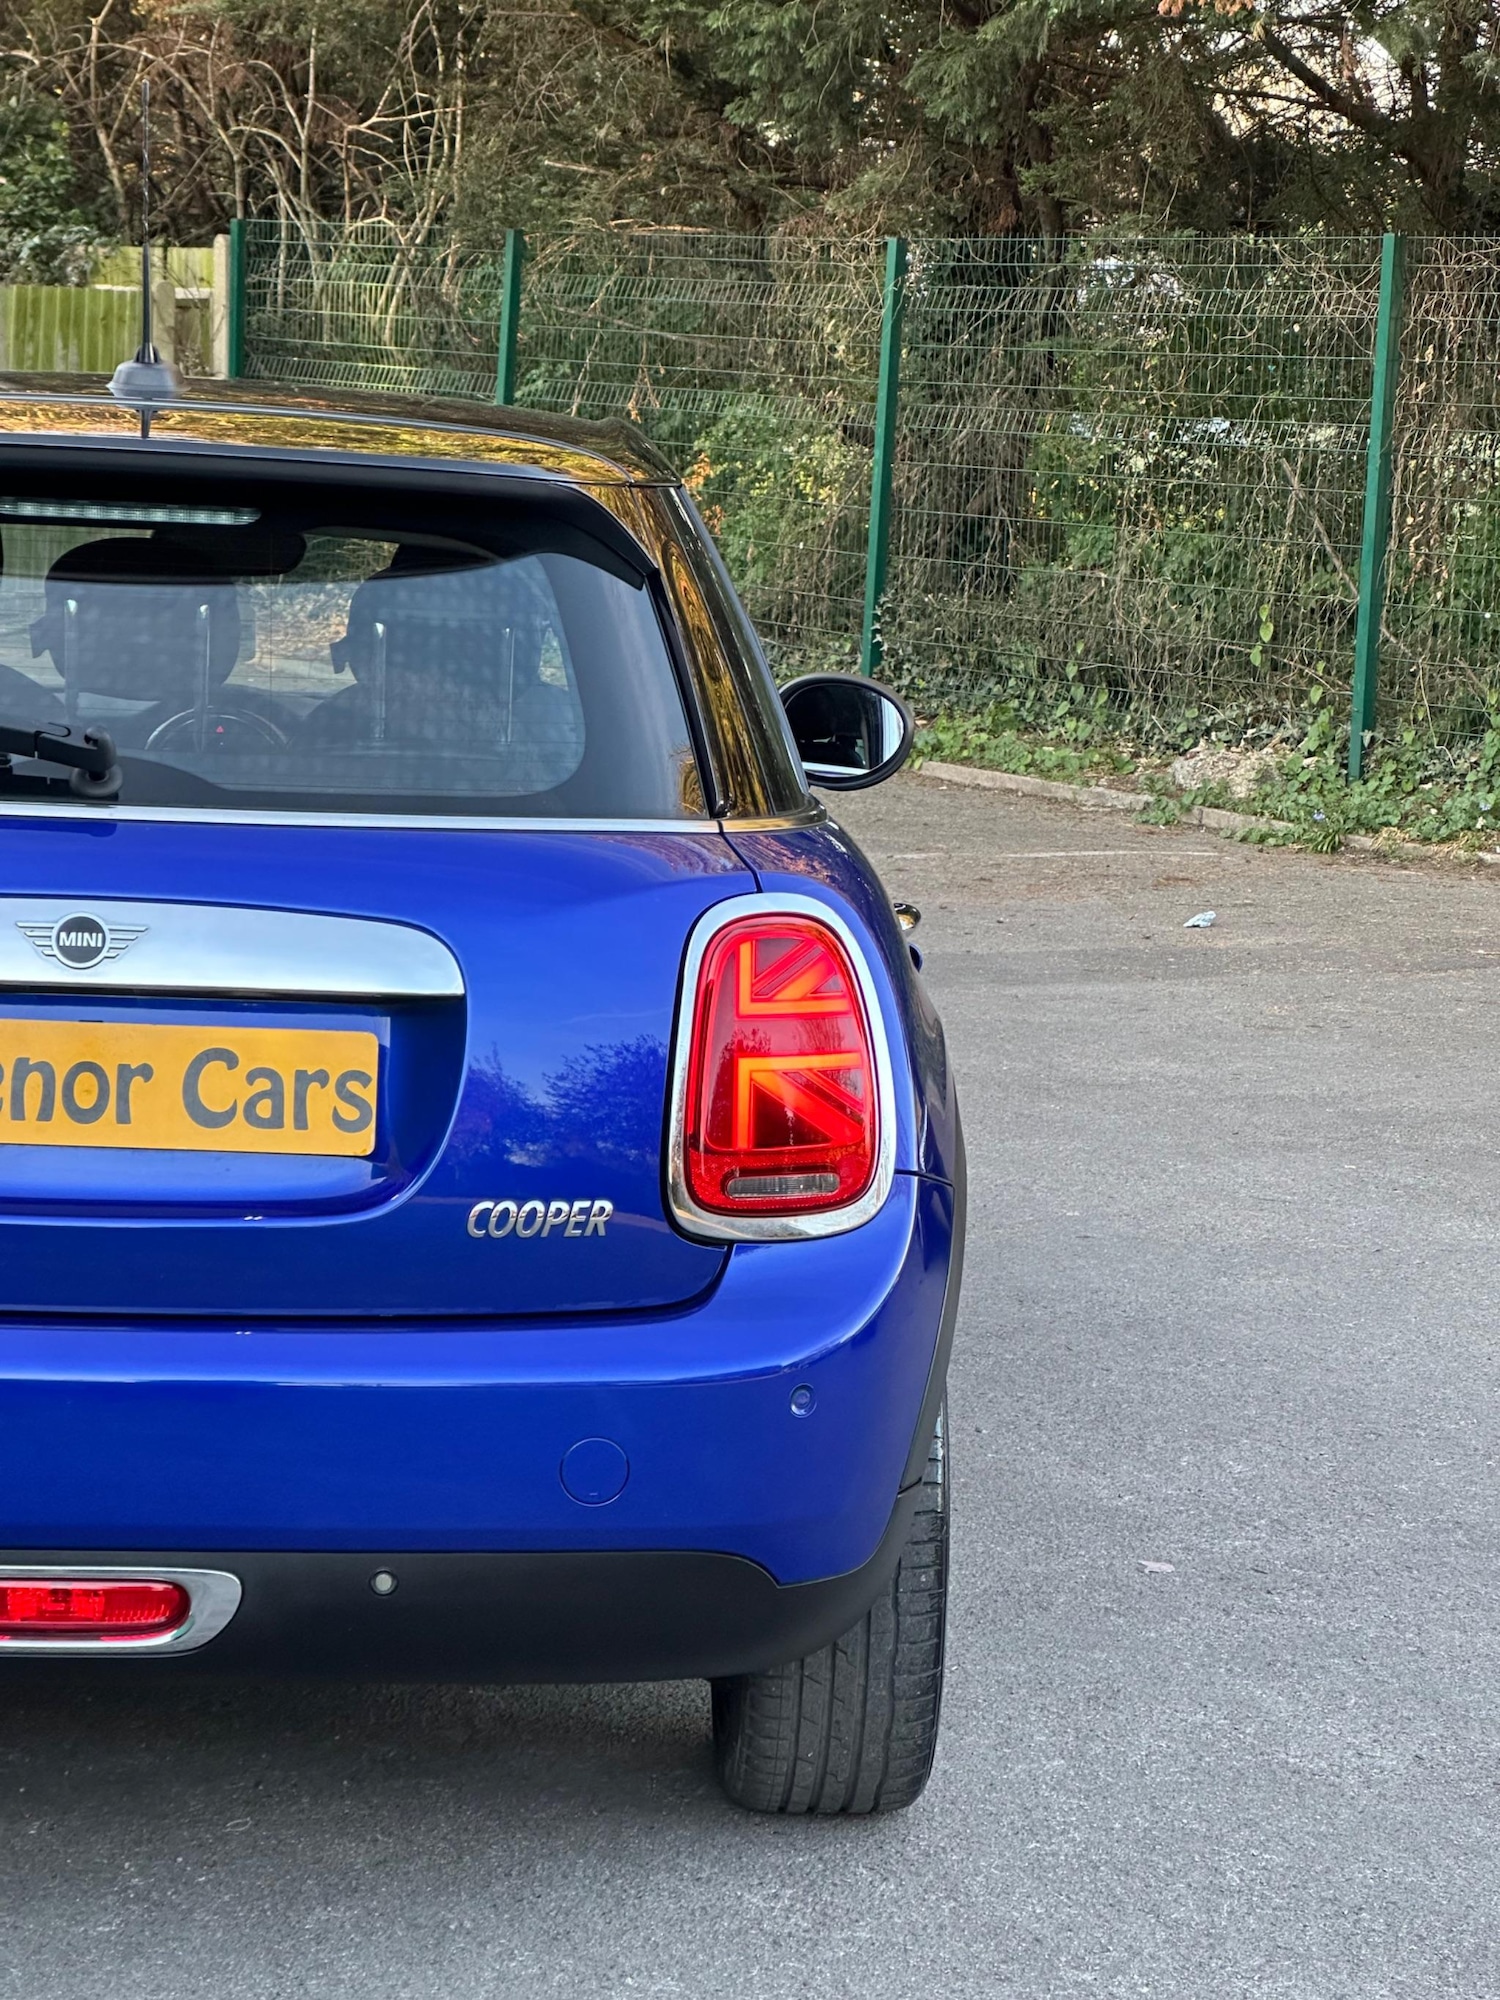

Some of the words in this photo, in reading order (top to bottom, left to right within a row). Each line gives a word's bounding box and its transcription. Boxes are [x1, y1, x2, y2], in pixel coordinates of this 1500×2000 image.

[59, 931, 103, 947] MINI
[0, 1056, 154, 1125] nor
[182, 1047, 373, 1134] Cars
[467, 1200, 613, 1238] COOPER
